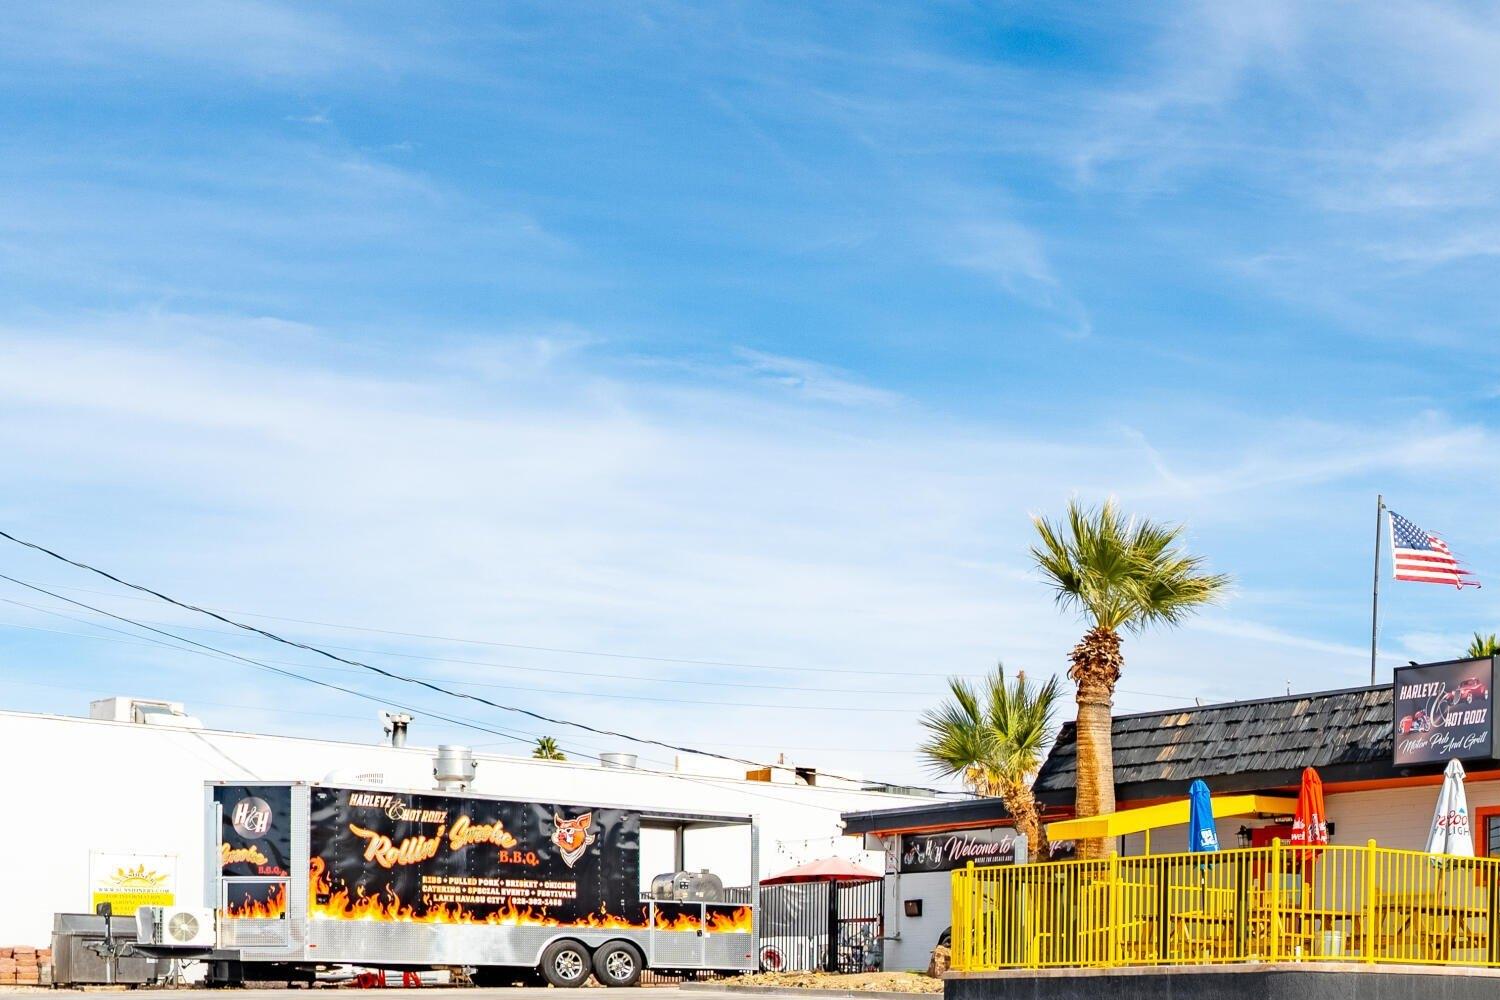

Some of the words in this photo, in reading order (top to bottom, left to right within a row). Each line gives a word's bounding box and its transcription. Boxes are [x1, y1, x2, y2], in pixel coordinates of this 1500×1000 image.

[1400, 682, 1440, 700] HARLEYZ
[1445, 711, 1463, 727] HOT
[1463, 708, 1487, 725] RODZ
[1399, 739, 1428, 754] Motor
[1430, 732, 1449, 750] Pub
[1440, 737, 1462, 754] And
[1463, 731, 1488, 750] Grill
[349, 793, 394, 808] HARLEYZ
[384, 798, 406, 821] &
[403, 808, 422, 822] HOT
[422, 810, 448, 823] RODZ
[1448, 826, 1470, 836] LIGH
[349, 823, 446, 869] Rollin'
[449, 815, 517, 851] Smoke
[944, 834, 998, 861] Welcome
[999, 834, 1010, 854] to
[499, 850, 540, 867] B.B.Q.
[422, 876, 442, 884] RIBS
[448, 876, 477, 886] PULLED
[478, 878, 499, 887] PORK
[505, 879, 539, 889] BRISKET
[544, 881, 577, 890] CHICKEN
[422, 884, 461, 894] CATERING
[467, 886, 500, 896] SPECIAL
[501, 888, 530, 897] EVENTS
[537, 889, 577, 899] FESTIVALS
[433, 894, 455, 902] LAKE
[455, 895, 486, 903] HAVASU
[486, 896, 506, 904] CITY
